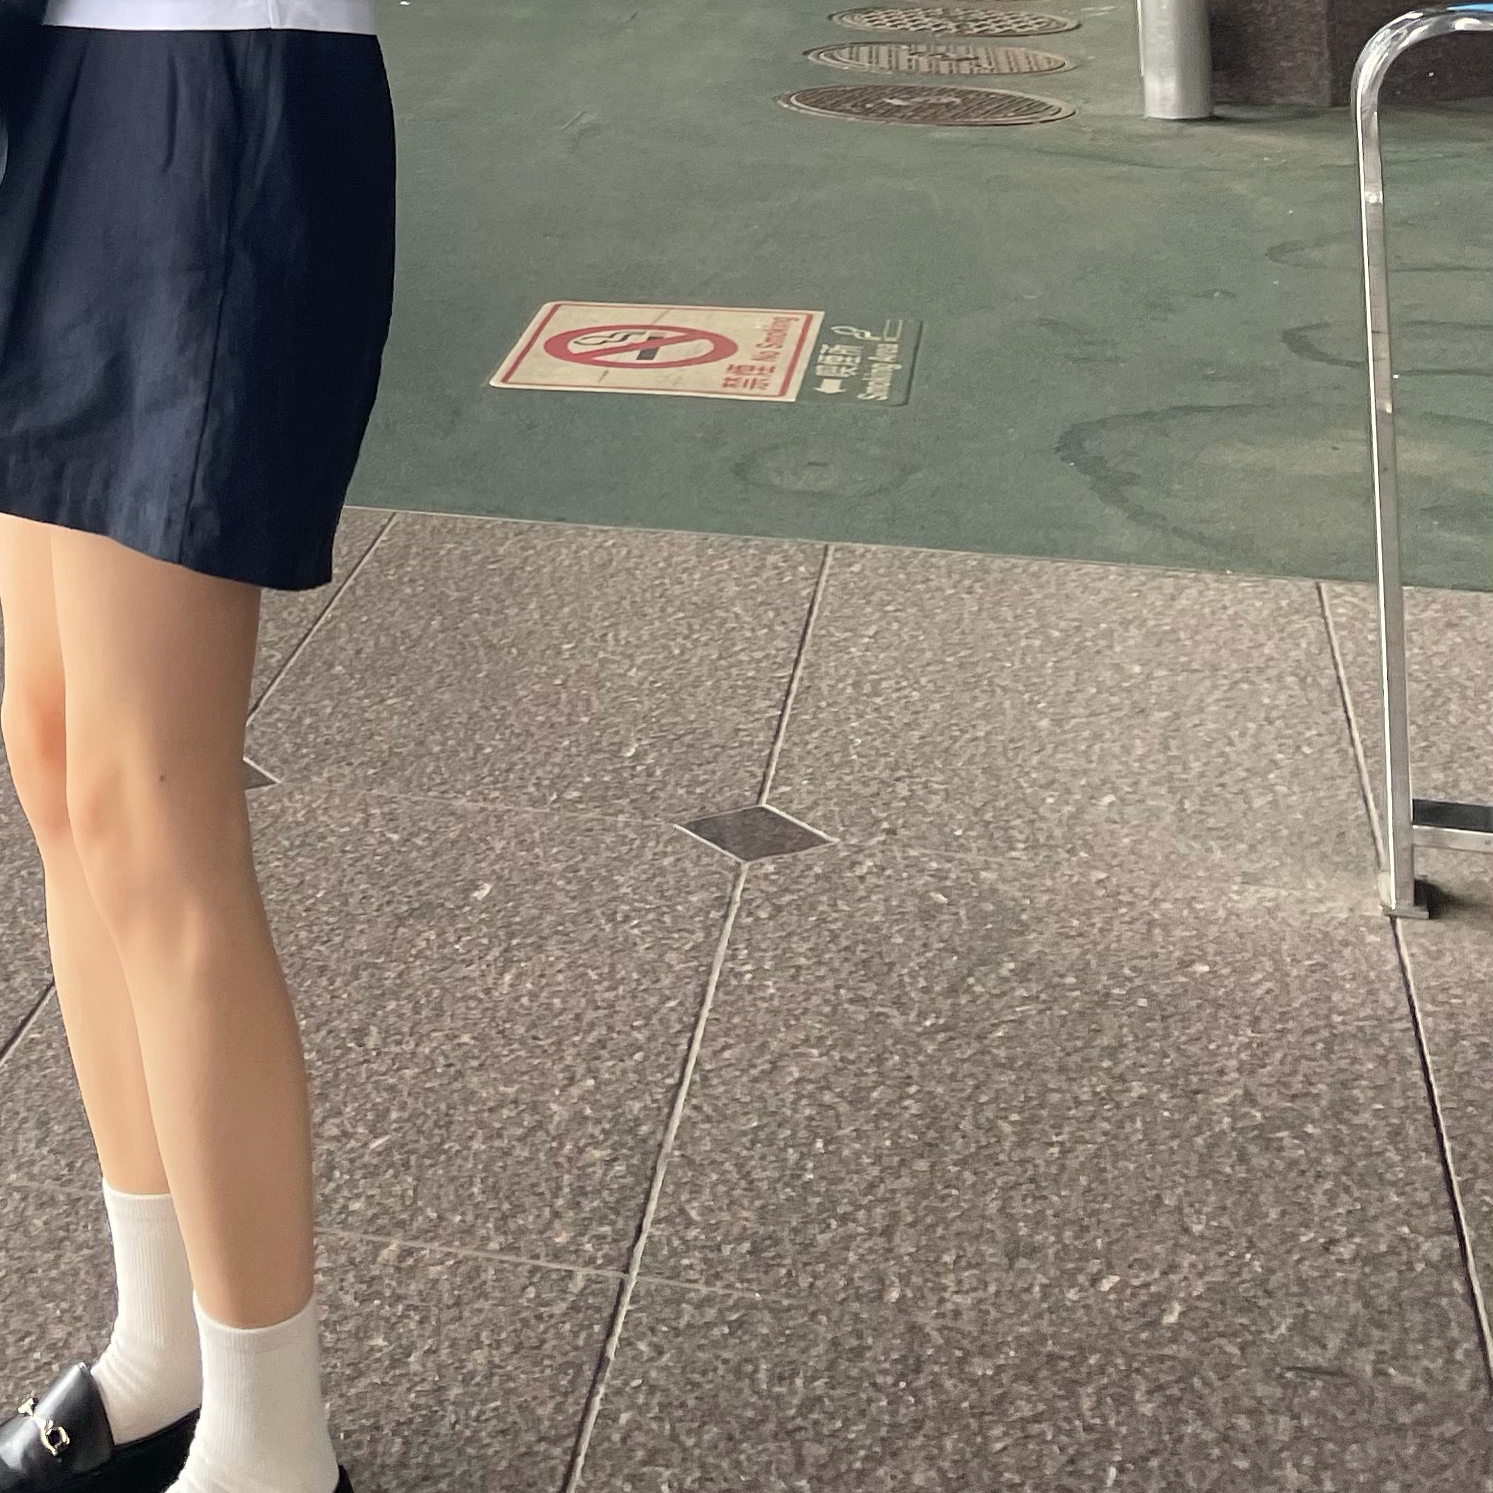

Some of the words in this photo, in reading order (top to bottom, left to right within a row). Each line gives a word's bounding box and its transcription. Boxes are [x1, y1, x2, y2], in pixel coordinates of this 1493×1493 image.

[756, 316, 800, 350] Smoking
[750, 350, 781, 362] No
[867, 342, 899, 364] Area
[721, 363, 775, 391] 禁煙
[856, 363, 902, 401] Smoking
